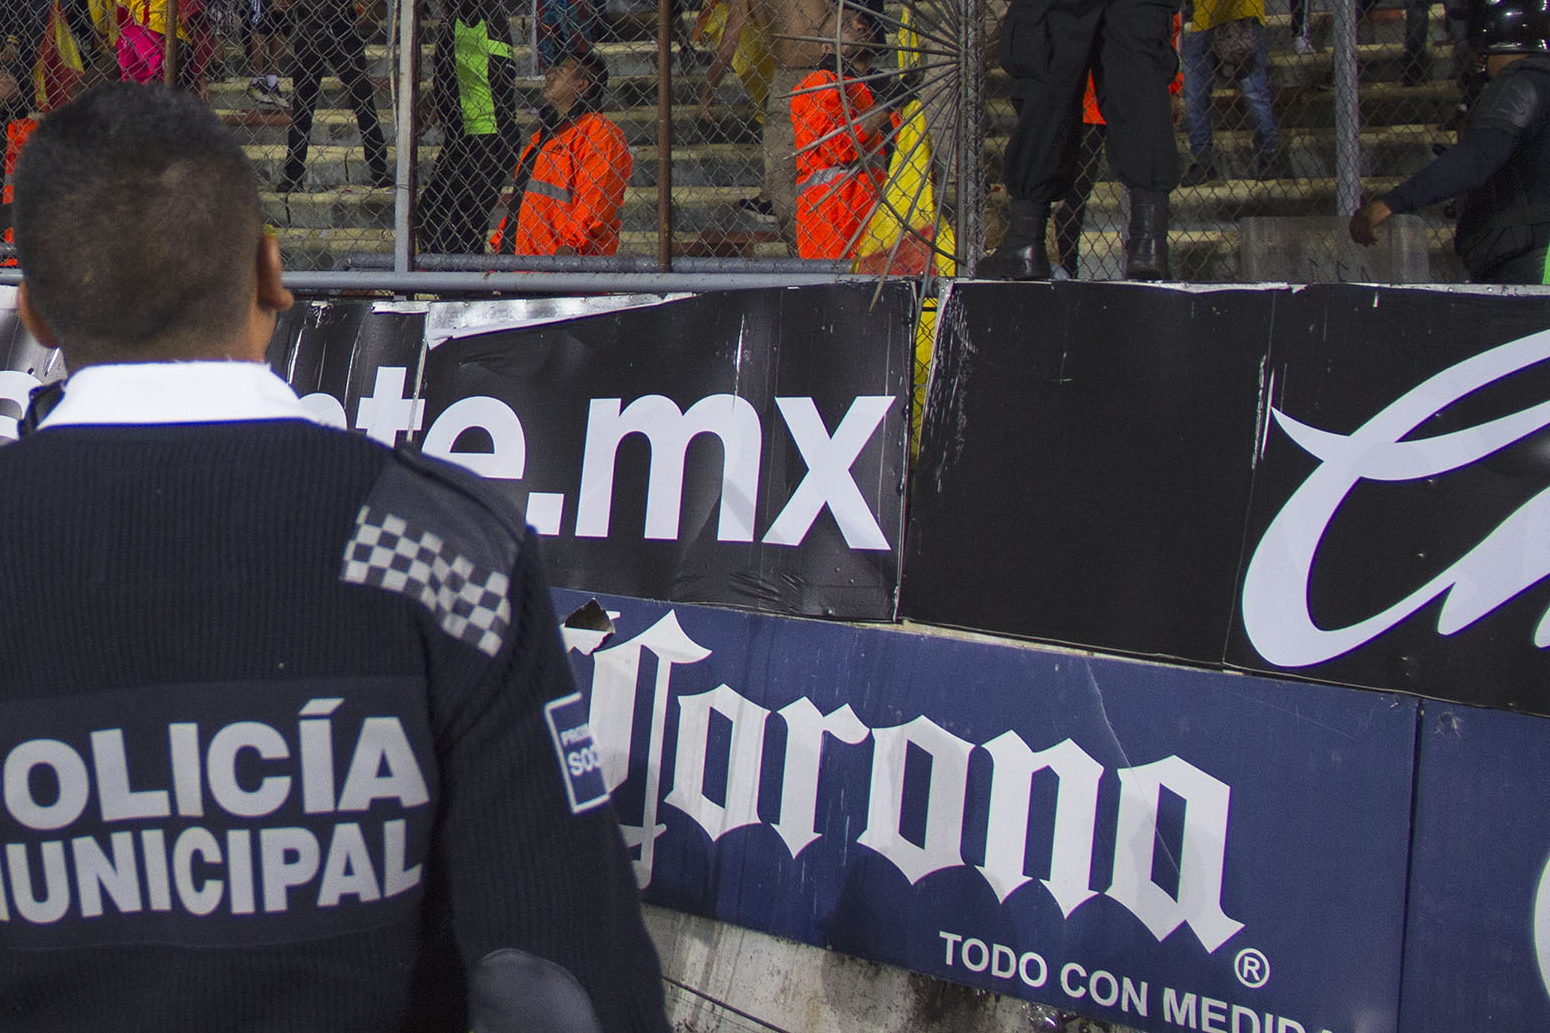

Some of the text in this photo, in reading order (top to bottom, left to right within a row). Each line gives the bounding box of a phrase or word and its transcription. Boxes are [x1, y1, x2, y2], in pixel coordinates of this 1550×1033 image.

[561, 609, 1245, 954] Corona
[939, 930, 1048, 988] TODO
[1060, 962, 1149, 1017] CON
